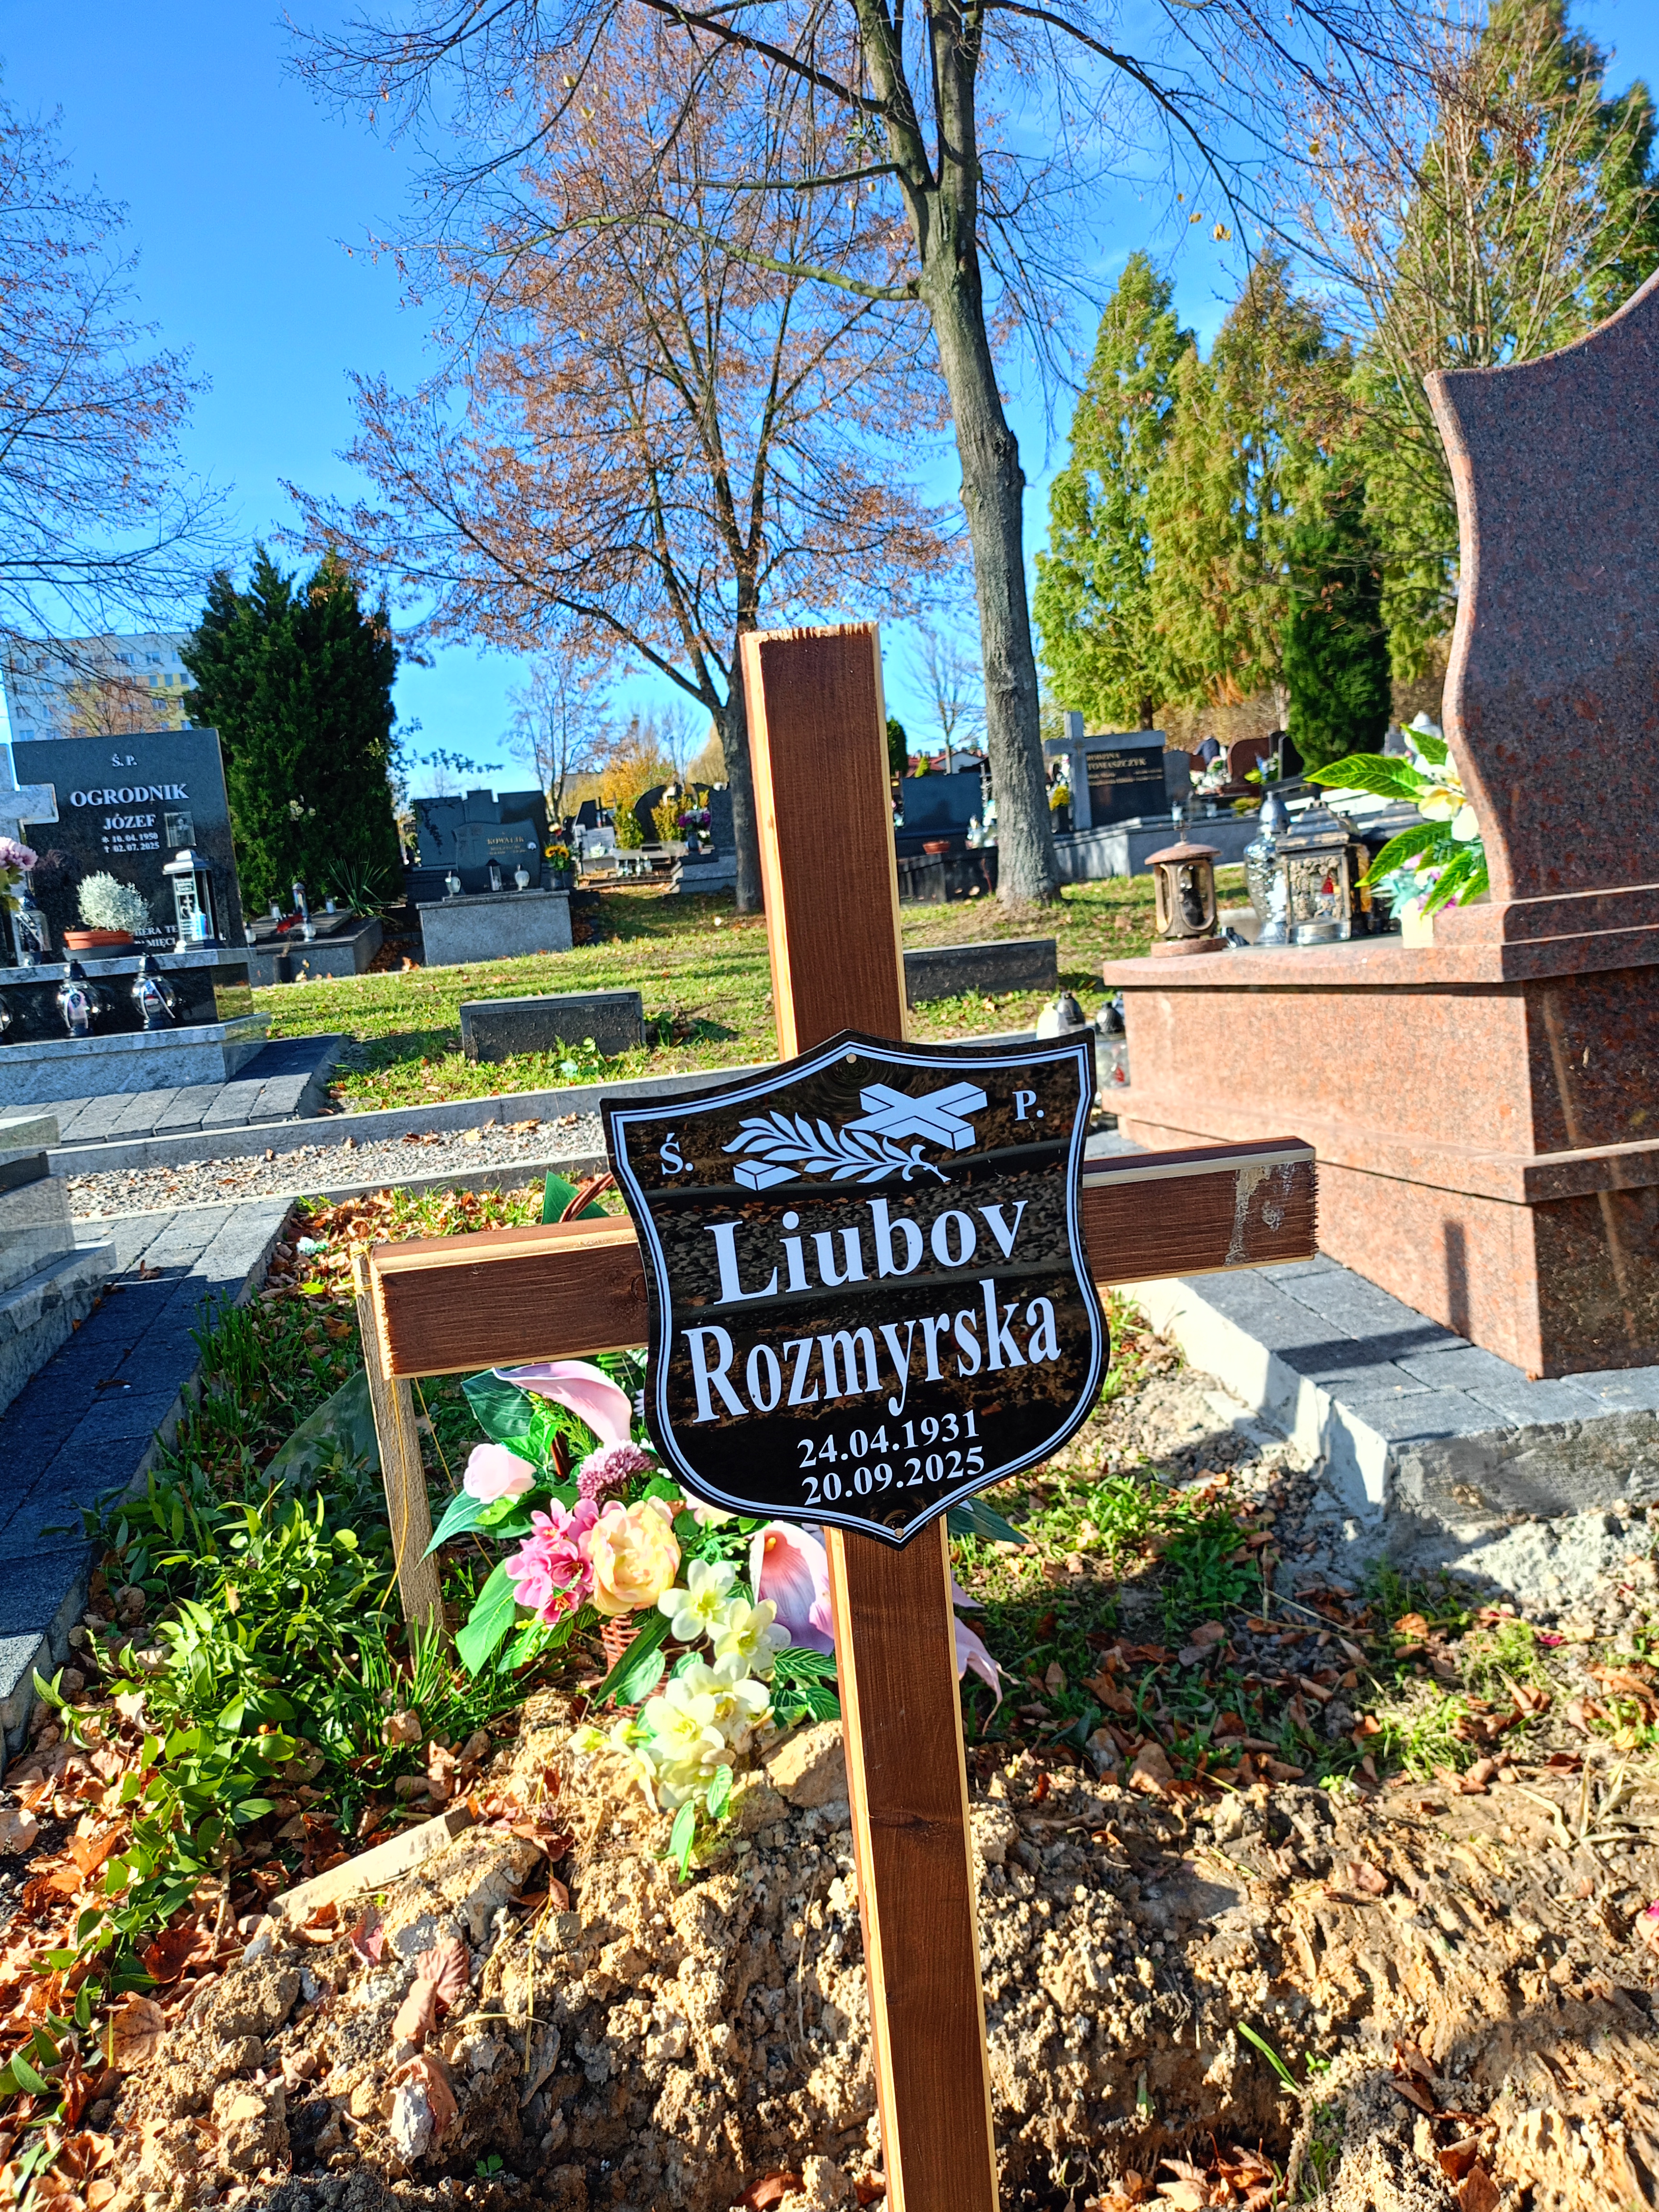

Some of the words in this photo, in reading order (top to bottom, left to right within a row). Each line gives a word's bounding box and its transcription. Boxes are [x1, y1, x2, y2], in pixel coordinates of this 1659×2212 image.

[125, 754, 138, 766] P.
[70, 783, 190, 807] OGRODNIK
[102, 813, 156, 830] JÓZEF
[659, 1132, 694, 1175] Ś.
[1012, 1090, 1045, 1121] P.
[704, 1198, 1029, 1306] Liubov
[680, 1278, 1062, 1424] Rozmyrska
[797, 1409, 980, 1469] 24.04.1931
[801, 1445, 985, 1506] 20.09.2025
